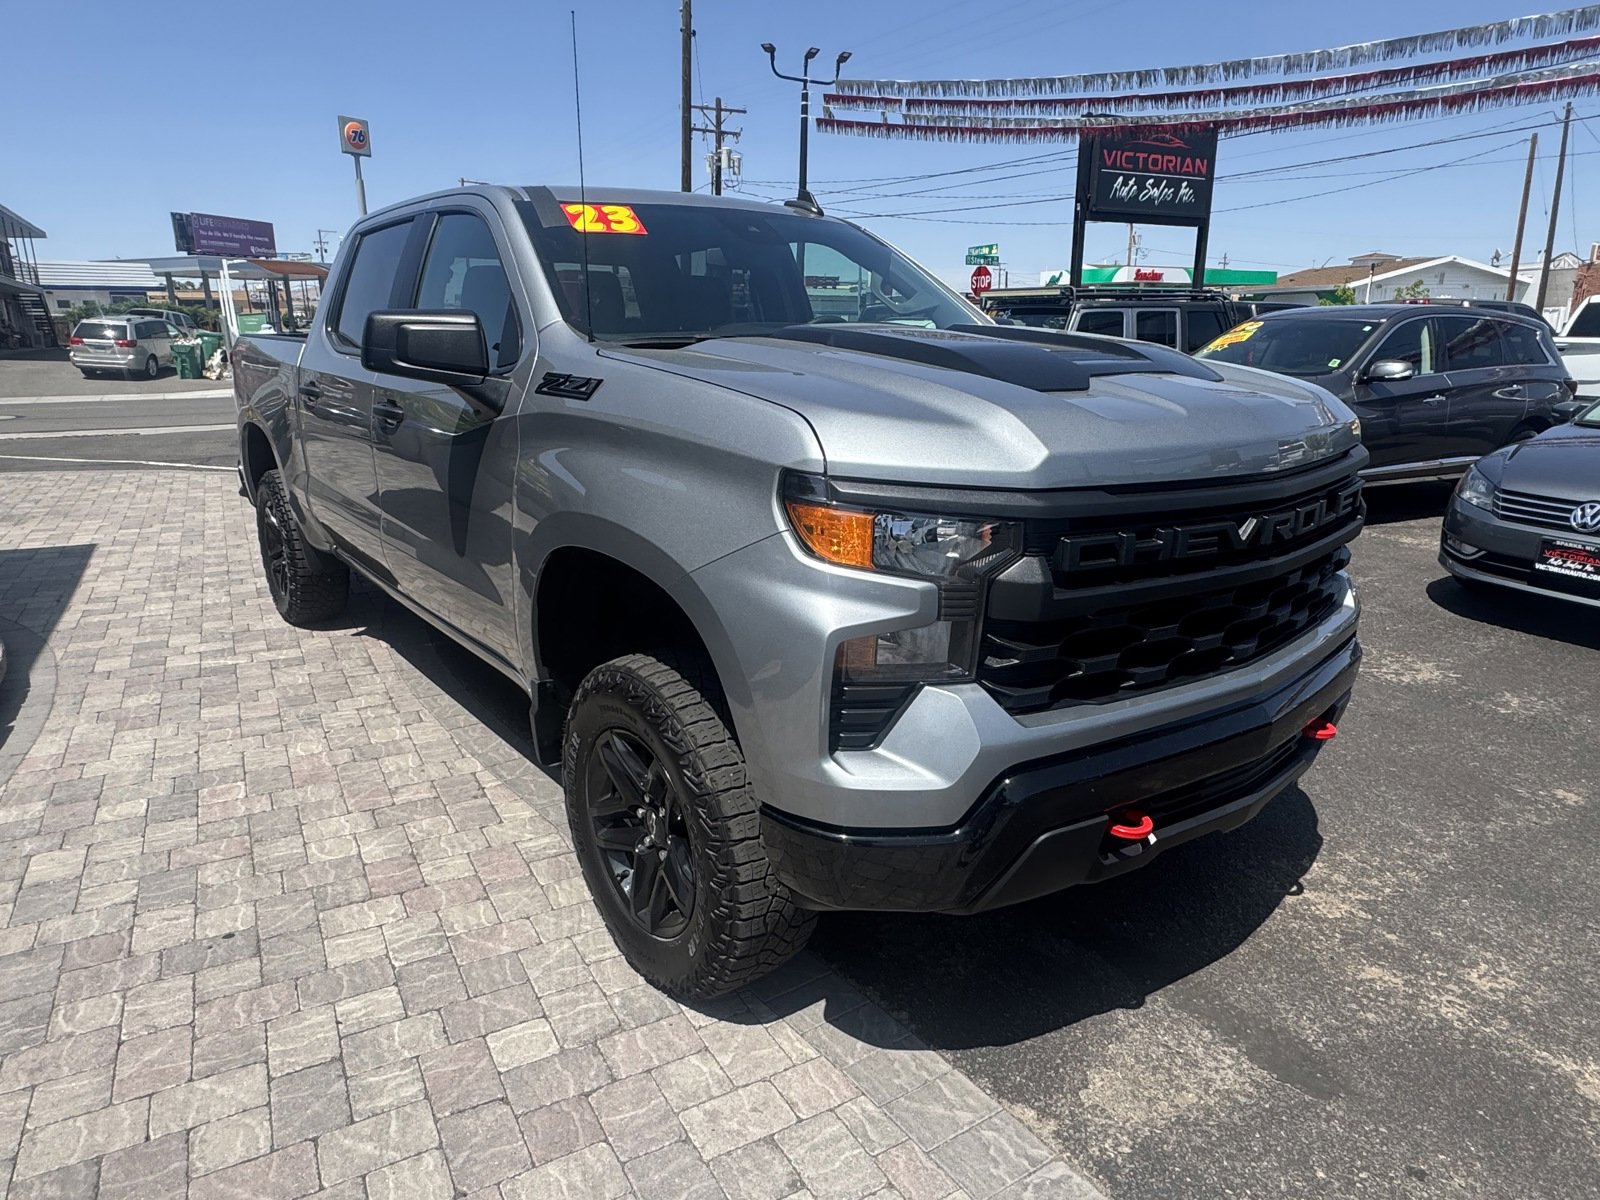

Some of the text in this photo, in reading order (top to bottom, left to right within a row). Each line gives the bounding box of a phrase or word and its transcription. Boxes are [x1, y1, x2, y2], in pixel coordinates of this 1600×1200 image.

[351, 129, 366, 143] 76
[1103, 149, 1208, 175] VICTORIAN
[1109, 176, 1138, 202] Auto
[1138, 178, 1175, 207] Sales
[565, 204, 639, 232] 23
[972, 276, 991, 289] STOP
[1054, 479, 1365, 572] CHEVROLET
